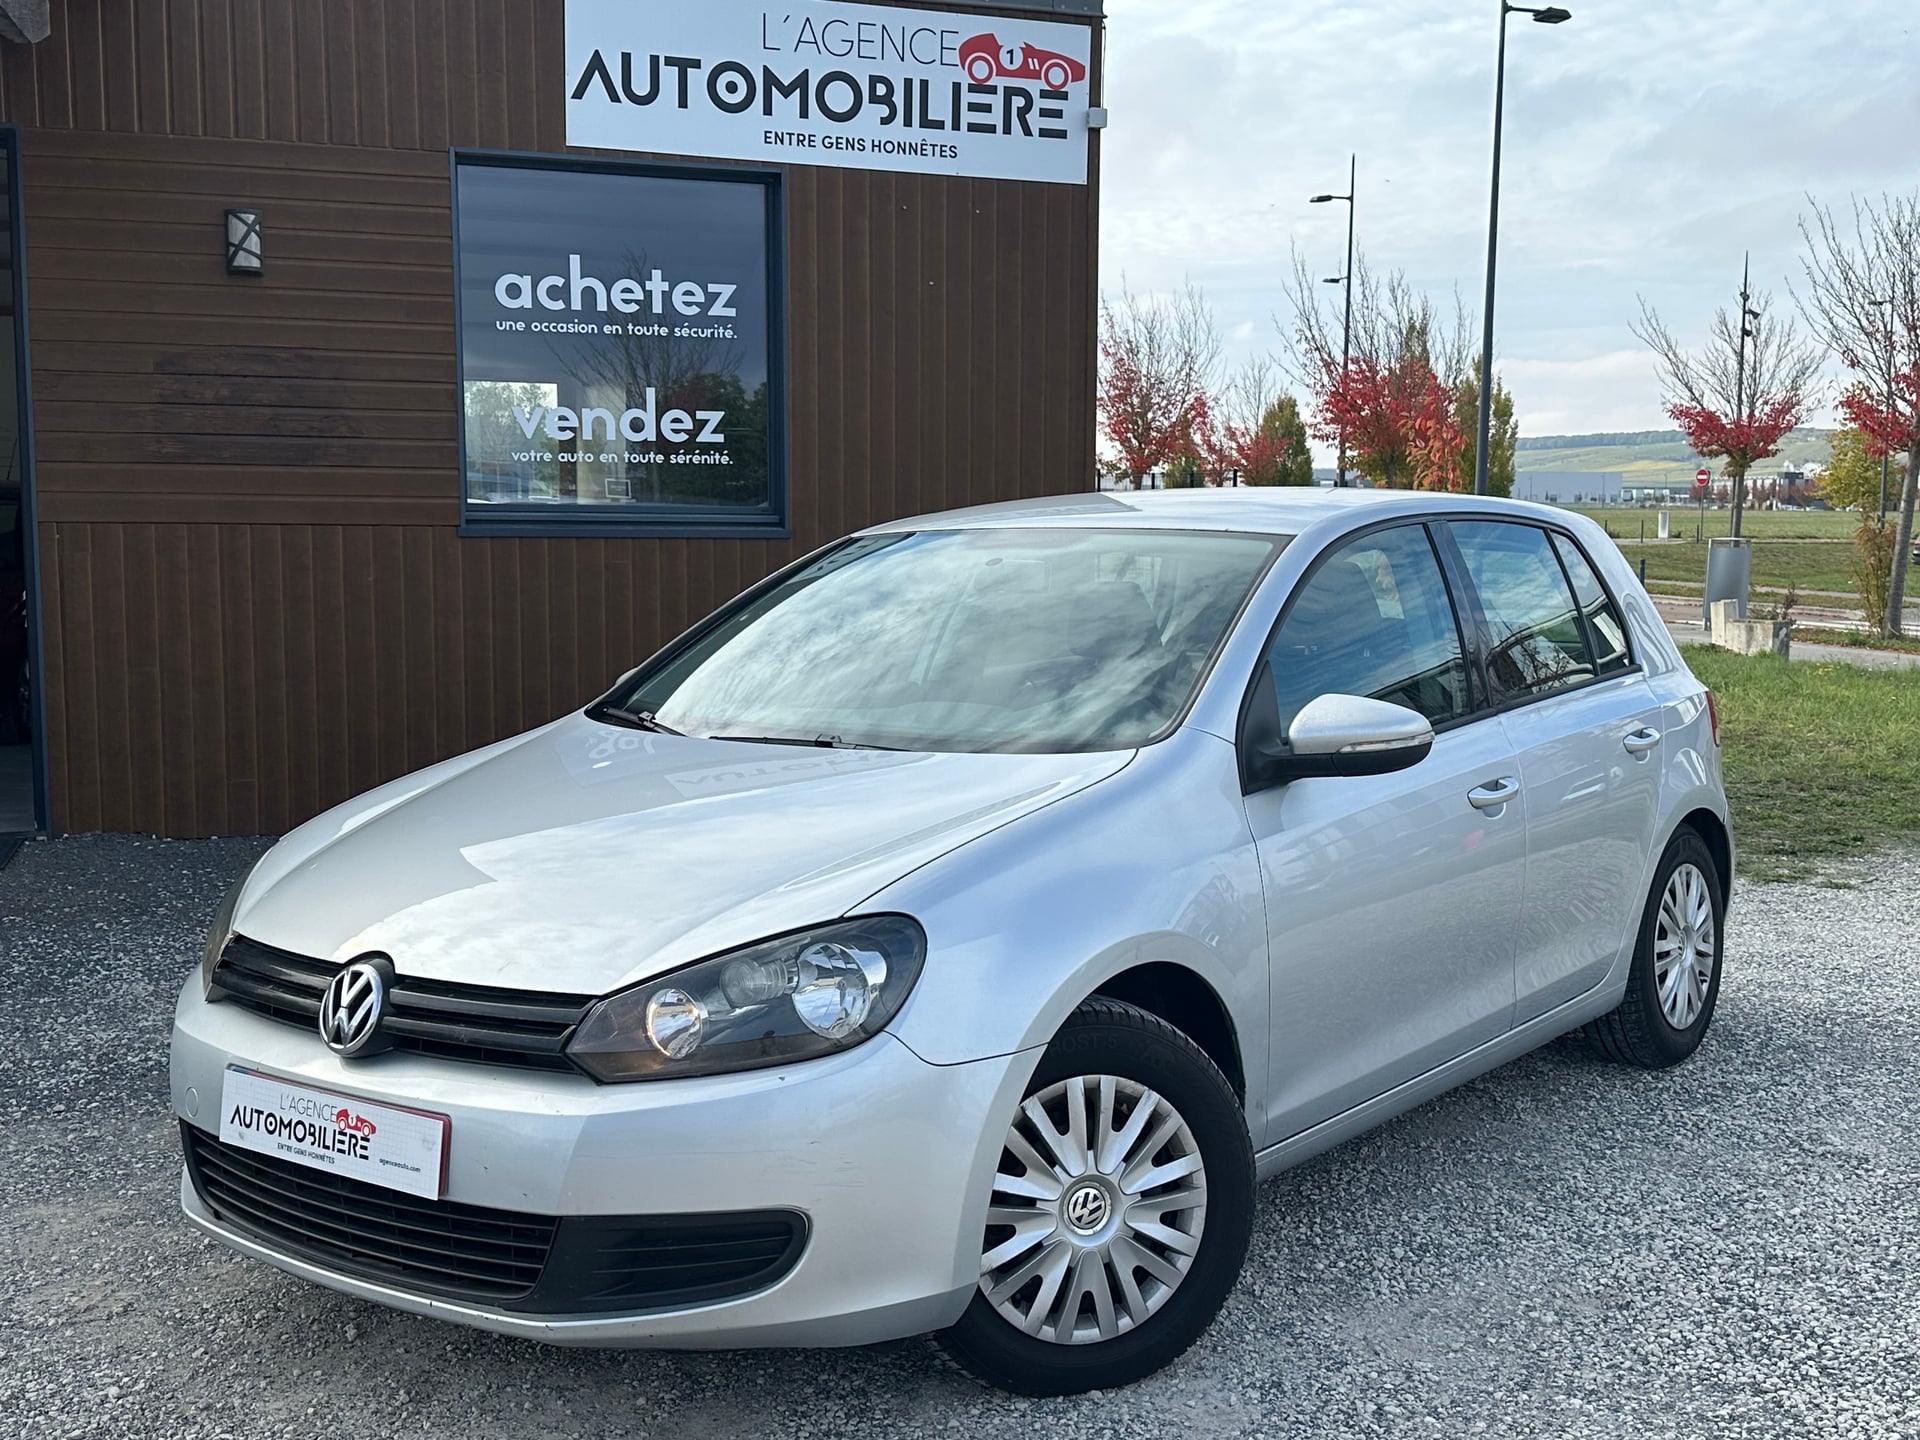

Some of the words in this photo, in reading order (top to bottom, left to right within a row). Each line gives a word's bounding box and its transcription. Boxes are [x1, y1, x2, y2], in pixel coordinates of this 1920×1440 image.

[570, 49, 1069, 139] AUTOMOBILIERE
[763, 130, 818, 148] ENTRE
[821, 133, 867, 152] GENS
[870, 137, 959, 159] HONNÊTES
[494, 254, 738, 318] achetez
[495, 319, 526, 332] une
[530, 319, 598, 335] occasion
[603, 325, 622, 335] en
[626, 323, 669, 337] toute
[673, 322, 738, 339] sécurité.
[511, 387, 725, 443] vendez
[511, 450, 553, 463] votre
[557, 450, 594, 463] auto
[599, 453, 618, 463] en
[623, 450, 665, 464] toute
[669, 448, 734, 465] sérénité.
[230, 1104, 371, 1161] AUTOMOBILIERE
